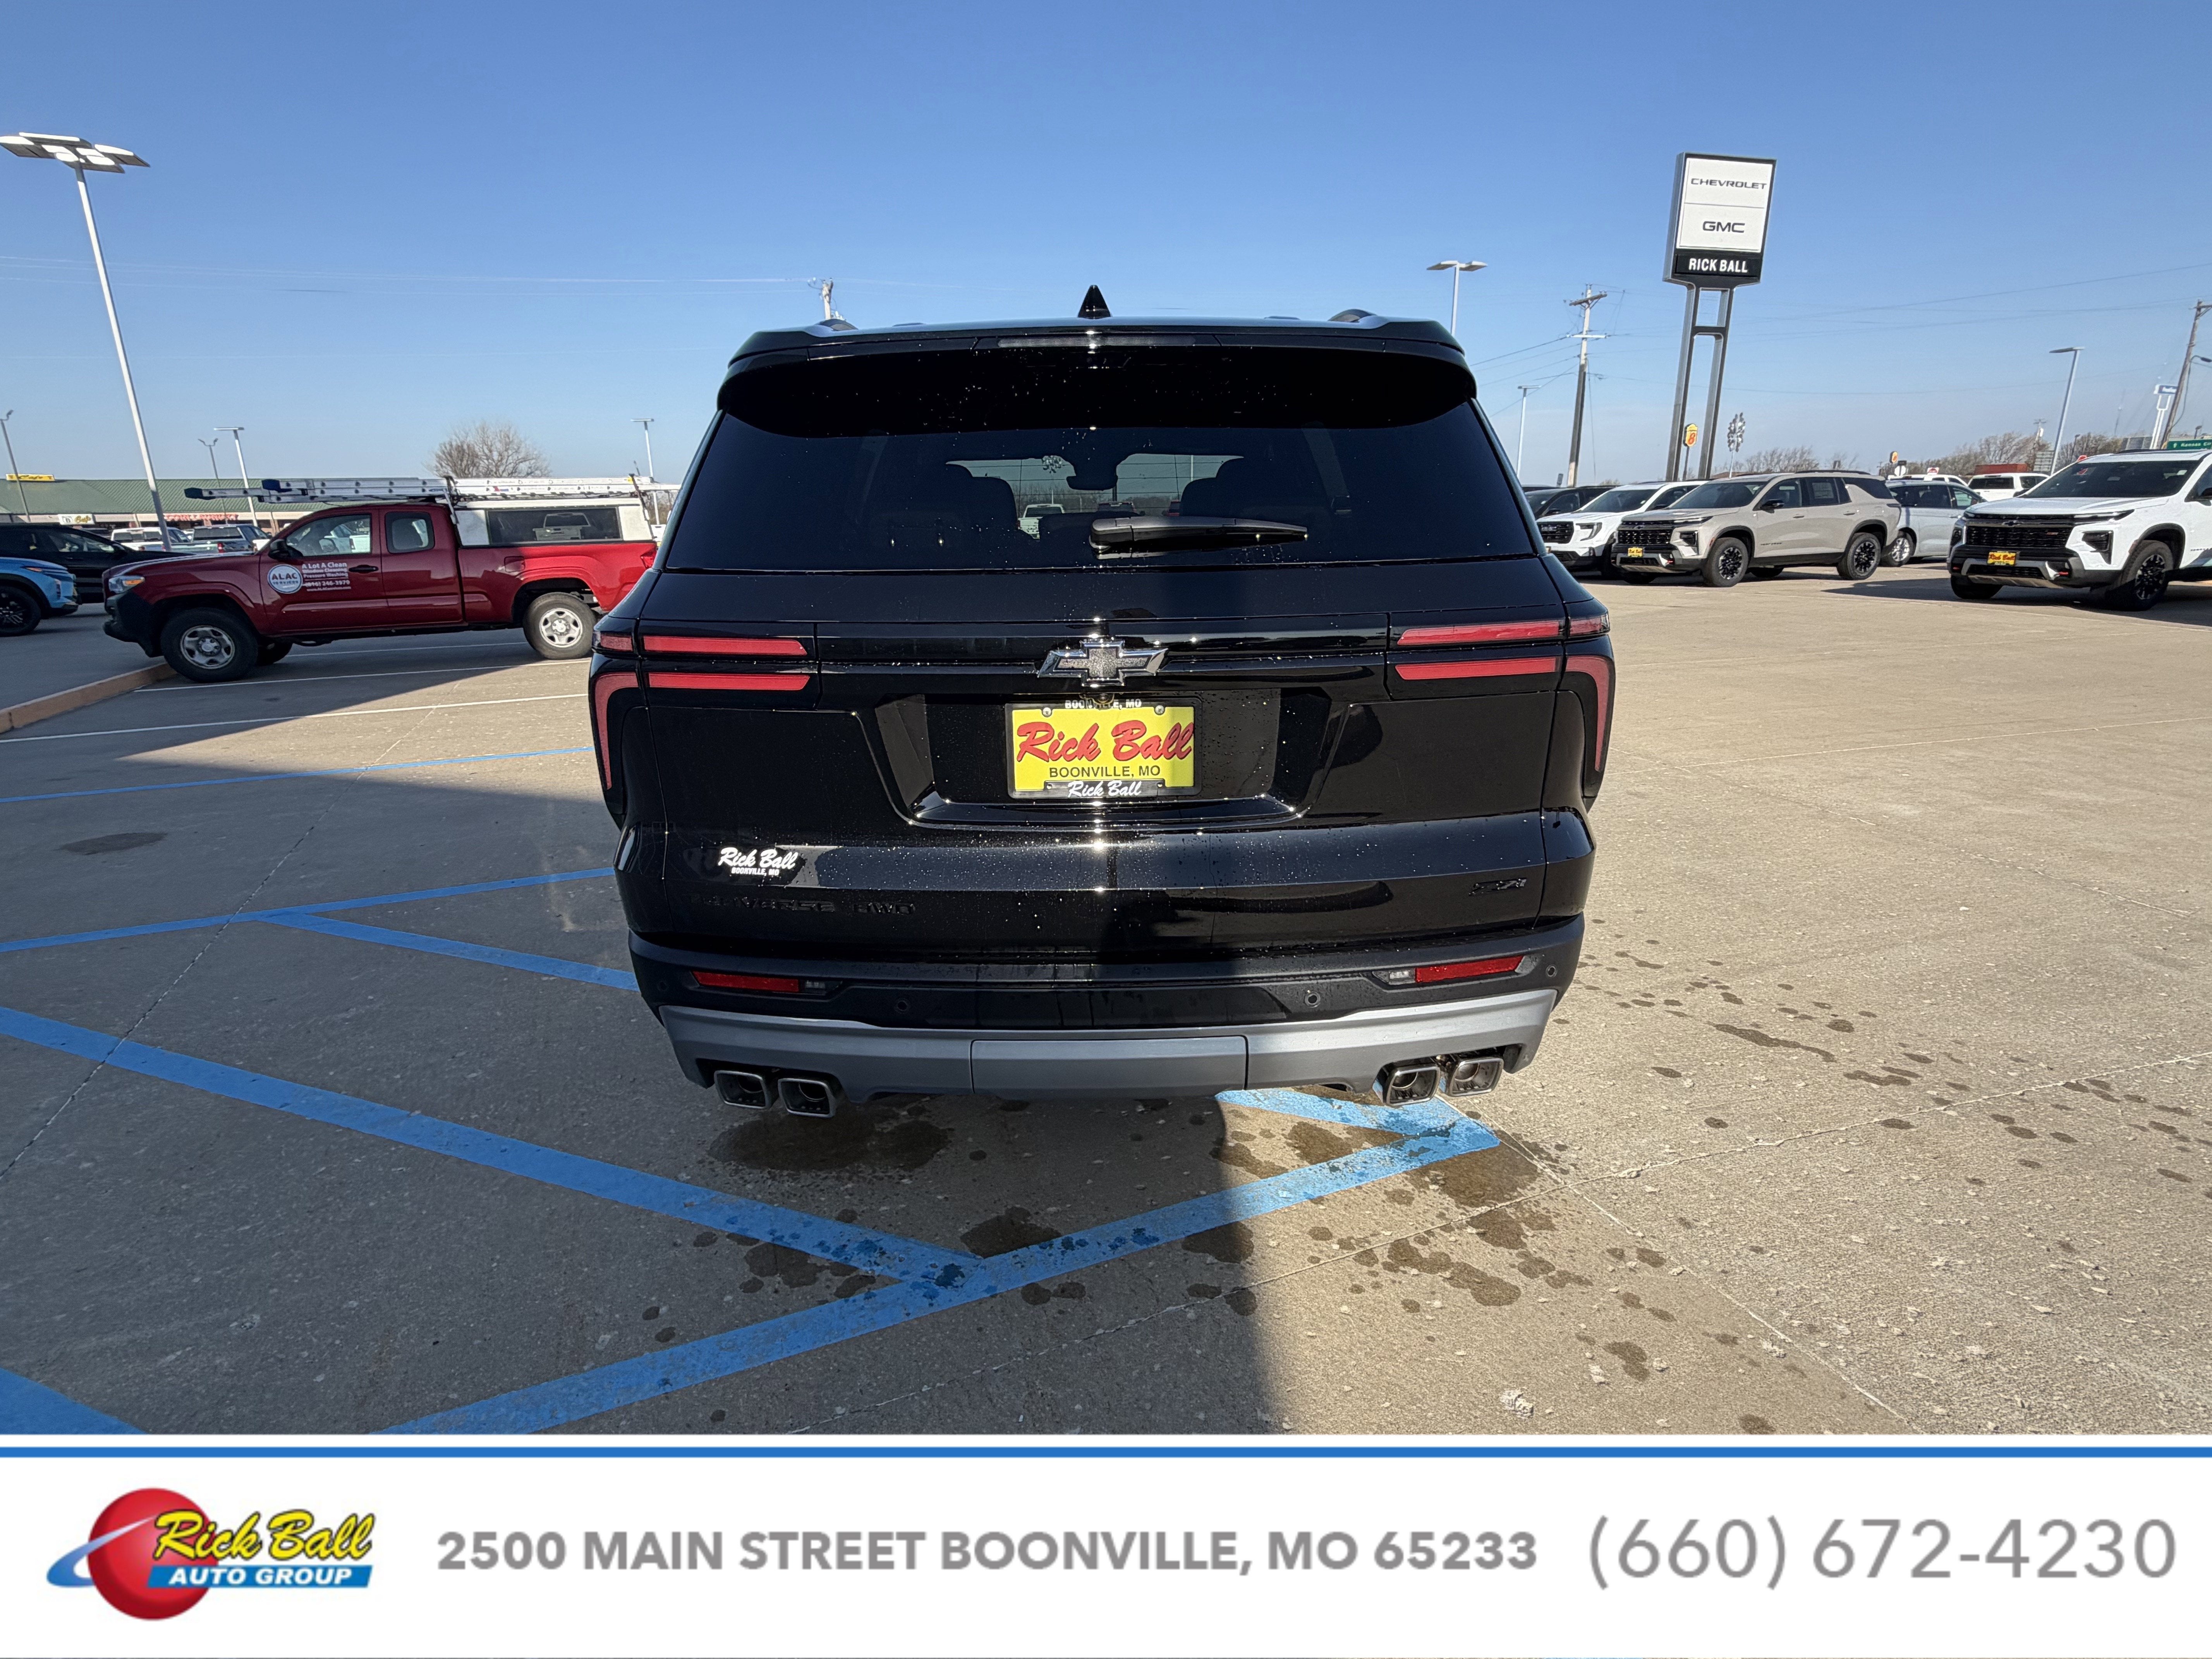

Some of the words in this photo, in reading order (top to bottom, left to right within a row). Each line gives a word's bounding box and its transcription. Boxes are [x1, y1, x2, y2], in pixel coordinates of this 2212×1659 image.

[1691, 178, 1767, 189] CHEVROLET
[1702, 221, 1745, 233] GMC
[1688, 258, 1717, 271] RICK
[1719, 259, 1748, 273] BALL
[1688, 432, 1695, 445] 8
[1125, 698, 1142, 708] MO
[1016, 721, 1102, 762] Rick
[1111, 720, 1195, 762] Ball
[1049, 766, 1134, 778] BOONVILLE,
[1139, 765, 1161, 776] MO
[1067, 781, 1104, 798] Rick
[1108, 781, 1142, 797] Ball
[718, 847, 757, 868] Rick
[759, 848, 799, 870] Ball
[731, 867, 767, 876] BOONVILLE,
